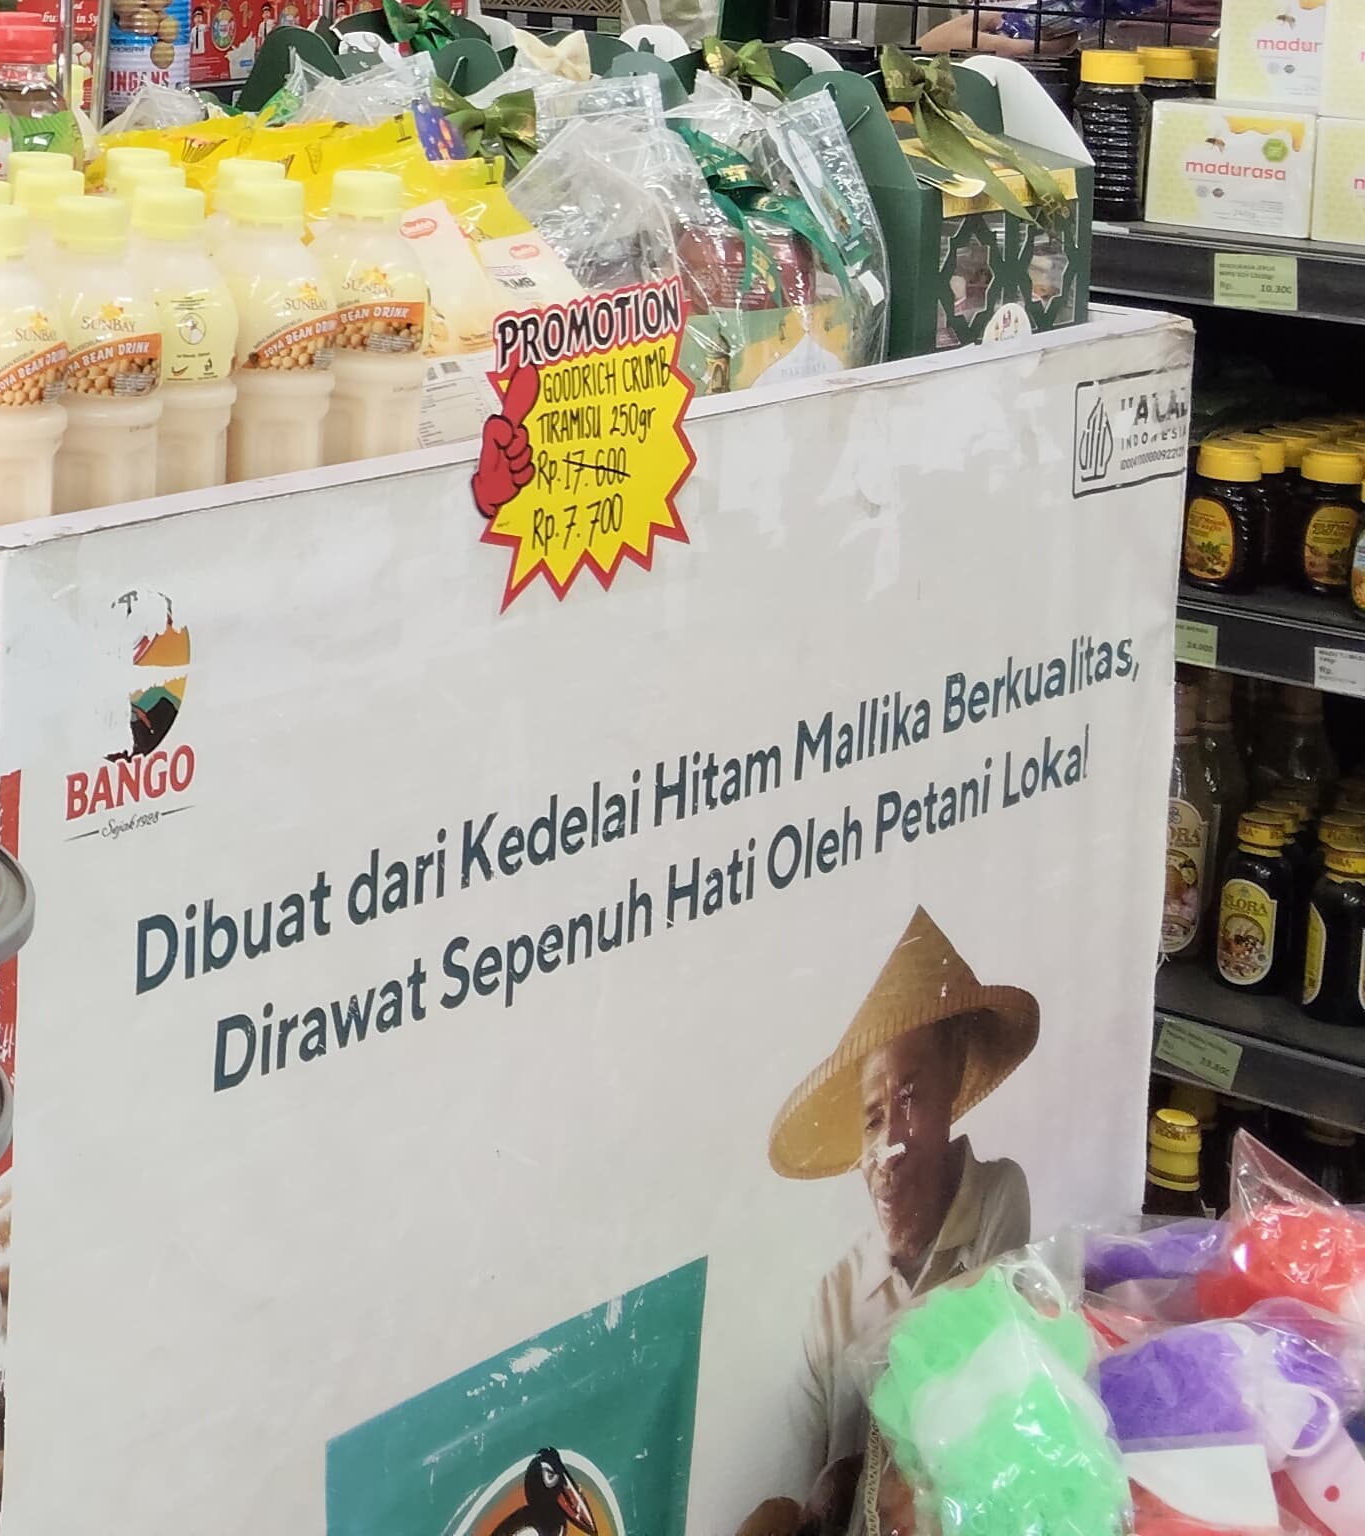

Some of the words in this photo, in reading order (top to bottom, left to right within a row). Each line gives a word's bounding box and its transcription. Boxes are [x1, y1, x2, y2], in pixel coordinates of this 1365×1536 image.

[1185, 160, 1286, 182] madurasa
[339, 307, 370, 324] BEAN
[372, 304, 410, 320] DRINK
[497, 283, 681, 368] PROMOTION
[117, 340, 150, 358] DRINK
[543, 363, 617, 404] GOODRICH
[622, 346, 671, 393] CRUMB
[537, 405, 601, 444] TIRAMISU
[610, 403, 656, 443] 250gr
[564, 494, 624, 550] 7.700
[65, 745, 196, 822] BANGO
[101, 815, 136, 840] Sejak
[136, 810, 160, 830] 1928
[135, 871, 333, 996] Dibuat
[347, 827, 447, 927] dari
[460, 767, 642, 889] Kedelai
[653, 743, 782, 827] Hitam
[792, 689, 930, 781] Mallika
[943, 635, 1141, 734] Berkualitas,
[213, 957, 428, 1093] Dirawat
[439, 877, 654, 1010] Sepenuh
[666, 836, 756, 928] Hati
[767, 804, 862, 890] Oleh
[874, 765, 990, 855] Petani
[1003, 723, 1090, 809] Lokal
